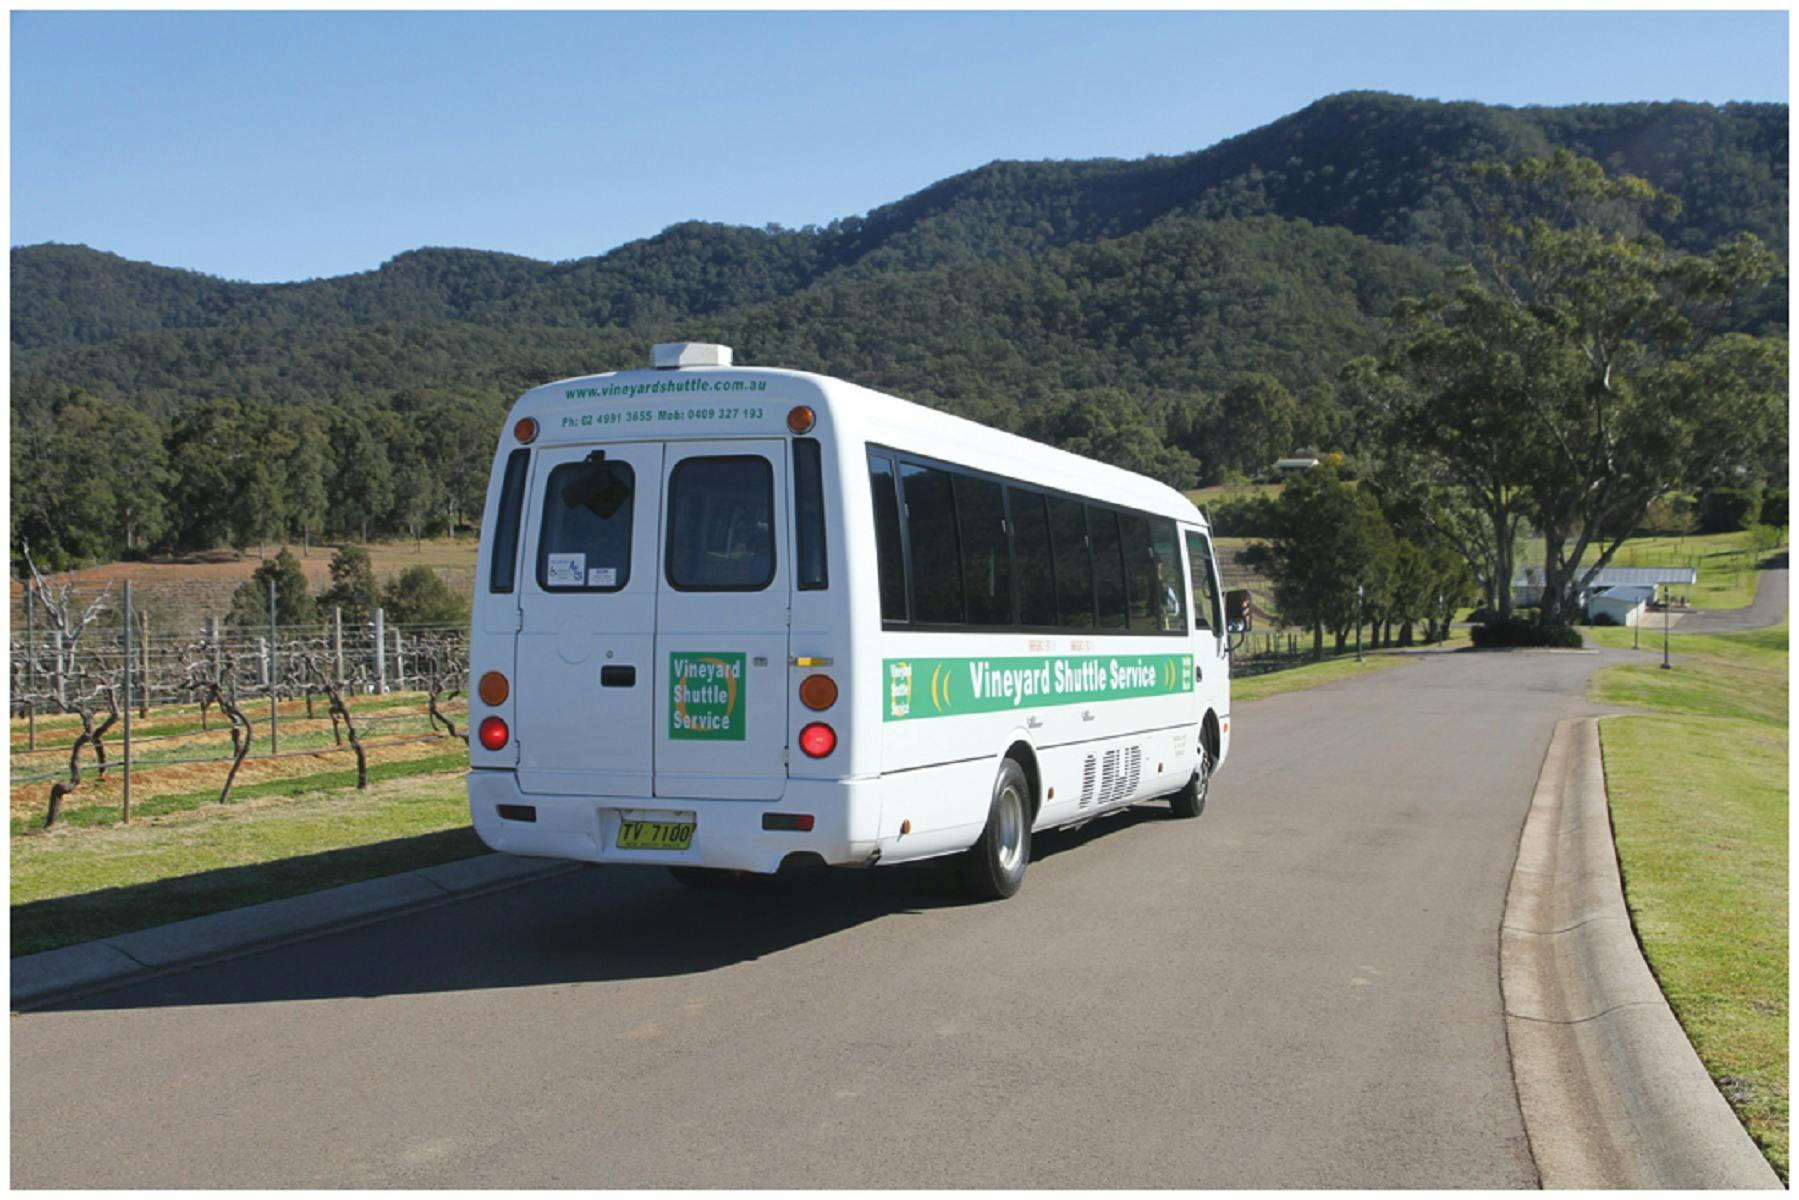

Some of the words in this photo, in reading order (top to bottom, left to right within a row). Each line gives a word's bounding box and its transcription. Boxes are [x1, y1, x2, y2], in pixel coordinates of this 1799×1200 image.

[565, 378, 767, 399] www.vineyardshuttle.com.au
[561, 416, 579, 428] Ph:
[581, 415, 593, 426] 02
[597, 413, 621, 424] 4991
[626, 410, 653, 422] 3655
[658, 409, 685, 421] Mob:
[687, 408, 715, 419] 0409
[718, 408, 739, 419] 327
[743, 408, 763, 419] 193
[674, 659, 740, 683] Vineyard
[969, 660, 1050, 706] Vineyard
[1054, 659, 1107, 694] Shuttle
[1110, 658, 1156, 690] Service
[674, 684, 727, 704] Shuttle
[674, 710, 730, 730] Service
[623, 822, 643, 841] TV
[652, 824, 691, 842] 7100
